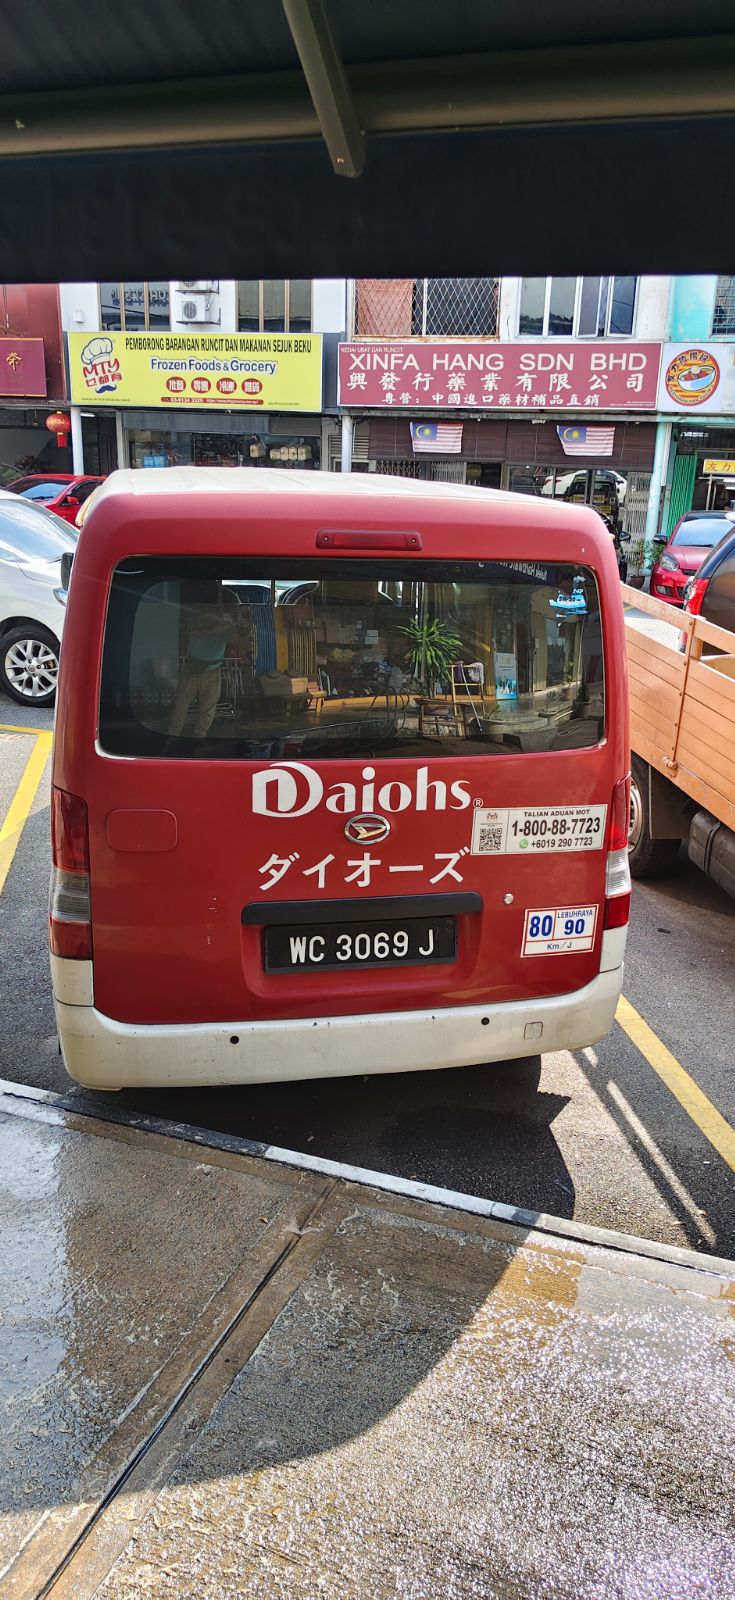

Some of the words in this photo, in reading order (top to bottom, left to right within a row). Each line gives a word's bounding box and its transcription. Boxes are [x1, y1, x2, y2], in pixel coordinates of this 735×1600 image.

[125, 338, 164, 350] PEMBORONG
[166, 338, 199, 351] BARANGAN
[201, 339, 224, 351] RUNCIT
[225, 339, 238, 352] DAN
[239, 339, 271, 352] MAKANAN
[272, 340, 293, 352] SEJUK
[294, 340, 312, 353] BEKU
[82, 358, 120, 378] MTY
[151, 359, 187, 370] Frozen
[188, 359, 221, 371] Foods
[223, 363, 229, 371] &
[230, 360, 276, 374] Grocery
[349, 353, 420, 370] XINFA
[432, 353, 504, 371] HANG
[520, 353, 574, 371] SDN
[590, 353, 647, 371] BHD
[347, 372, 644, 392] 興發行藥業有限公司
[252, 762, 472, 818] Daiohs
[511, 817, 601, 837] 1-800-88-7723
[531, 839, 556, 849] +6019
[557, 838, 572, 848] 290
[574, 837, 593, 847] 7723
[258, 846, 470, 891] ダイオーズ
[557, 909, 593, 919] LEBUHRAYA
[529, 915, 553, 938] 80
[564, 919, 585, 935] 90
[289, 935, 326, 964] WC
[335, 930, 409, 961] 3069
[418, 929, 434, 956] J
